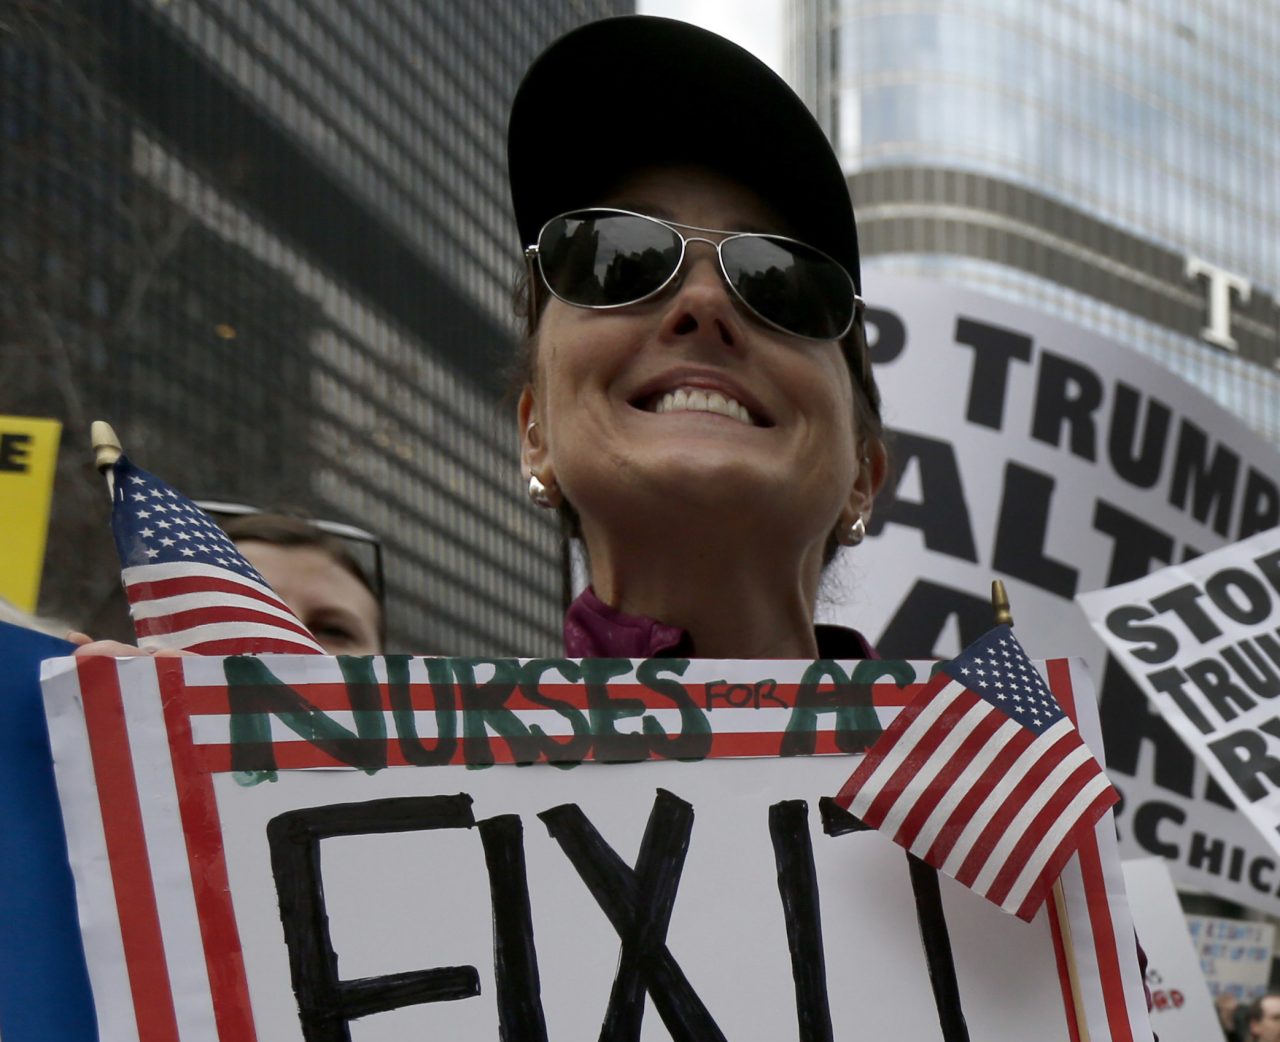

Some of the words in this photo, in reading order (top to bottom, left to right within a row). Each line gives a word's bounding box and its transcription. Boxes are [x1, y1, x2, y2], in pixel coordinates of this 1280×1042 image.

[223, 654, 713, 785] NURSES
[704, 677, 789, 713] FOR
[780, 656, 950, 758] AC
